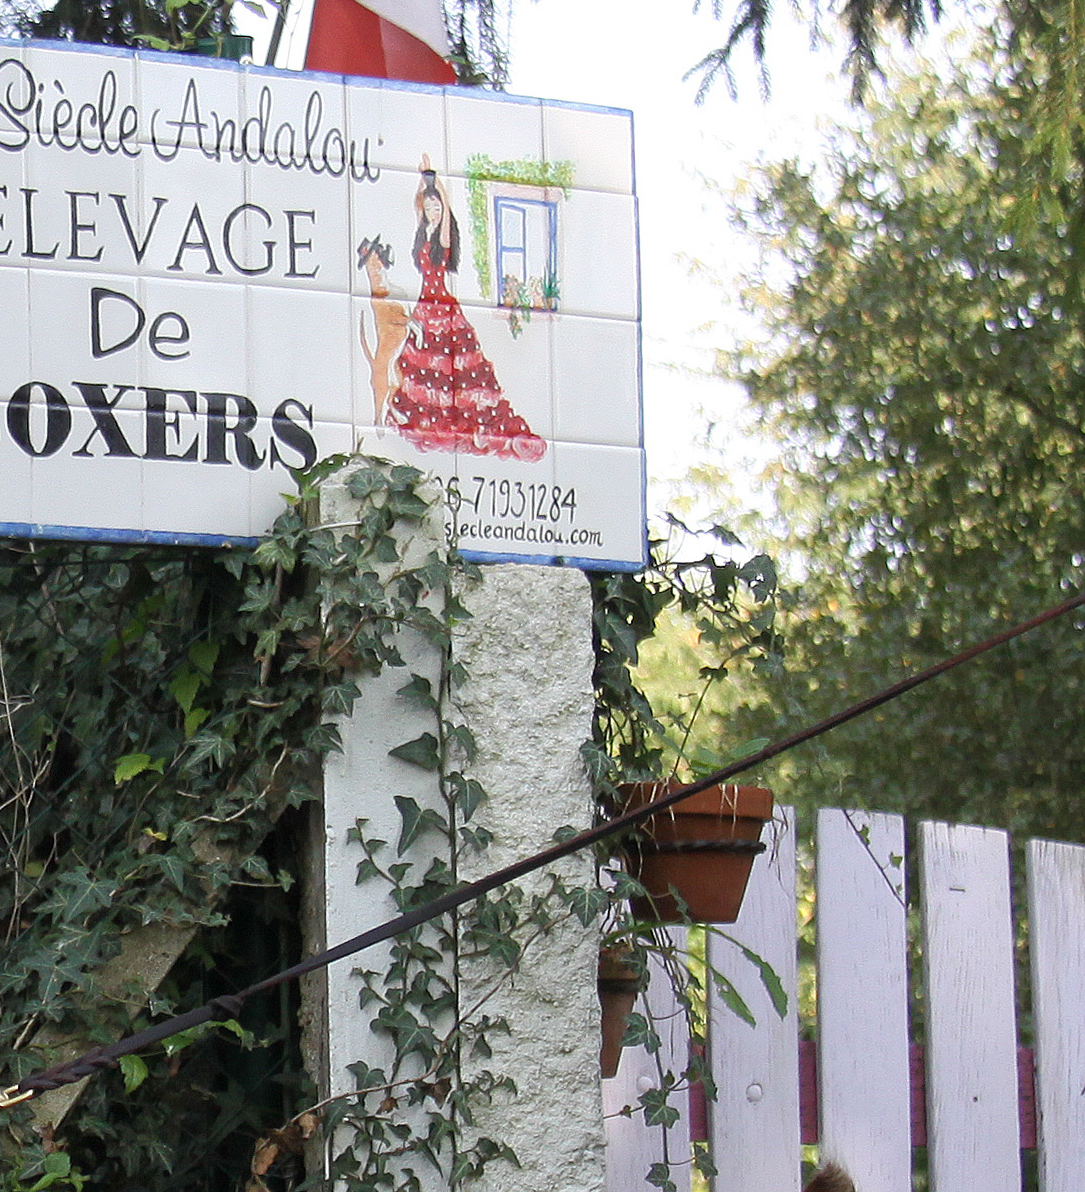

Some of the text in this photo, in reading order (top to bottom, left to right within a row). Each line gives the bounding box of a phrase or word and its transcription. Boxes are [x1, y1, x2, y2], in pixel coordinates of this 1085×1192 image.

[151, 77, 381, 183] Andalou
[90, 287, 191, 361] De
[472, 476, 577, 524] 71931284
